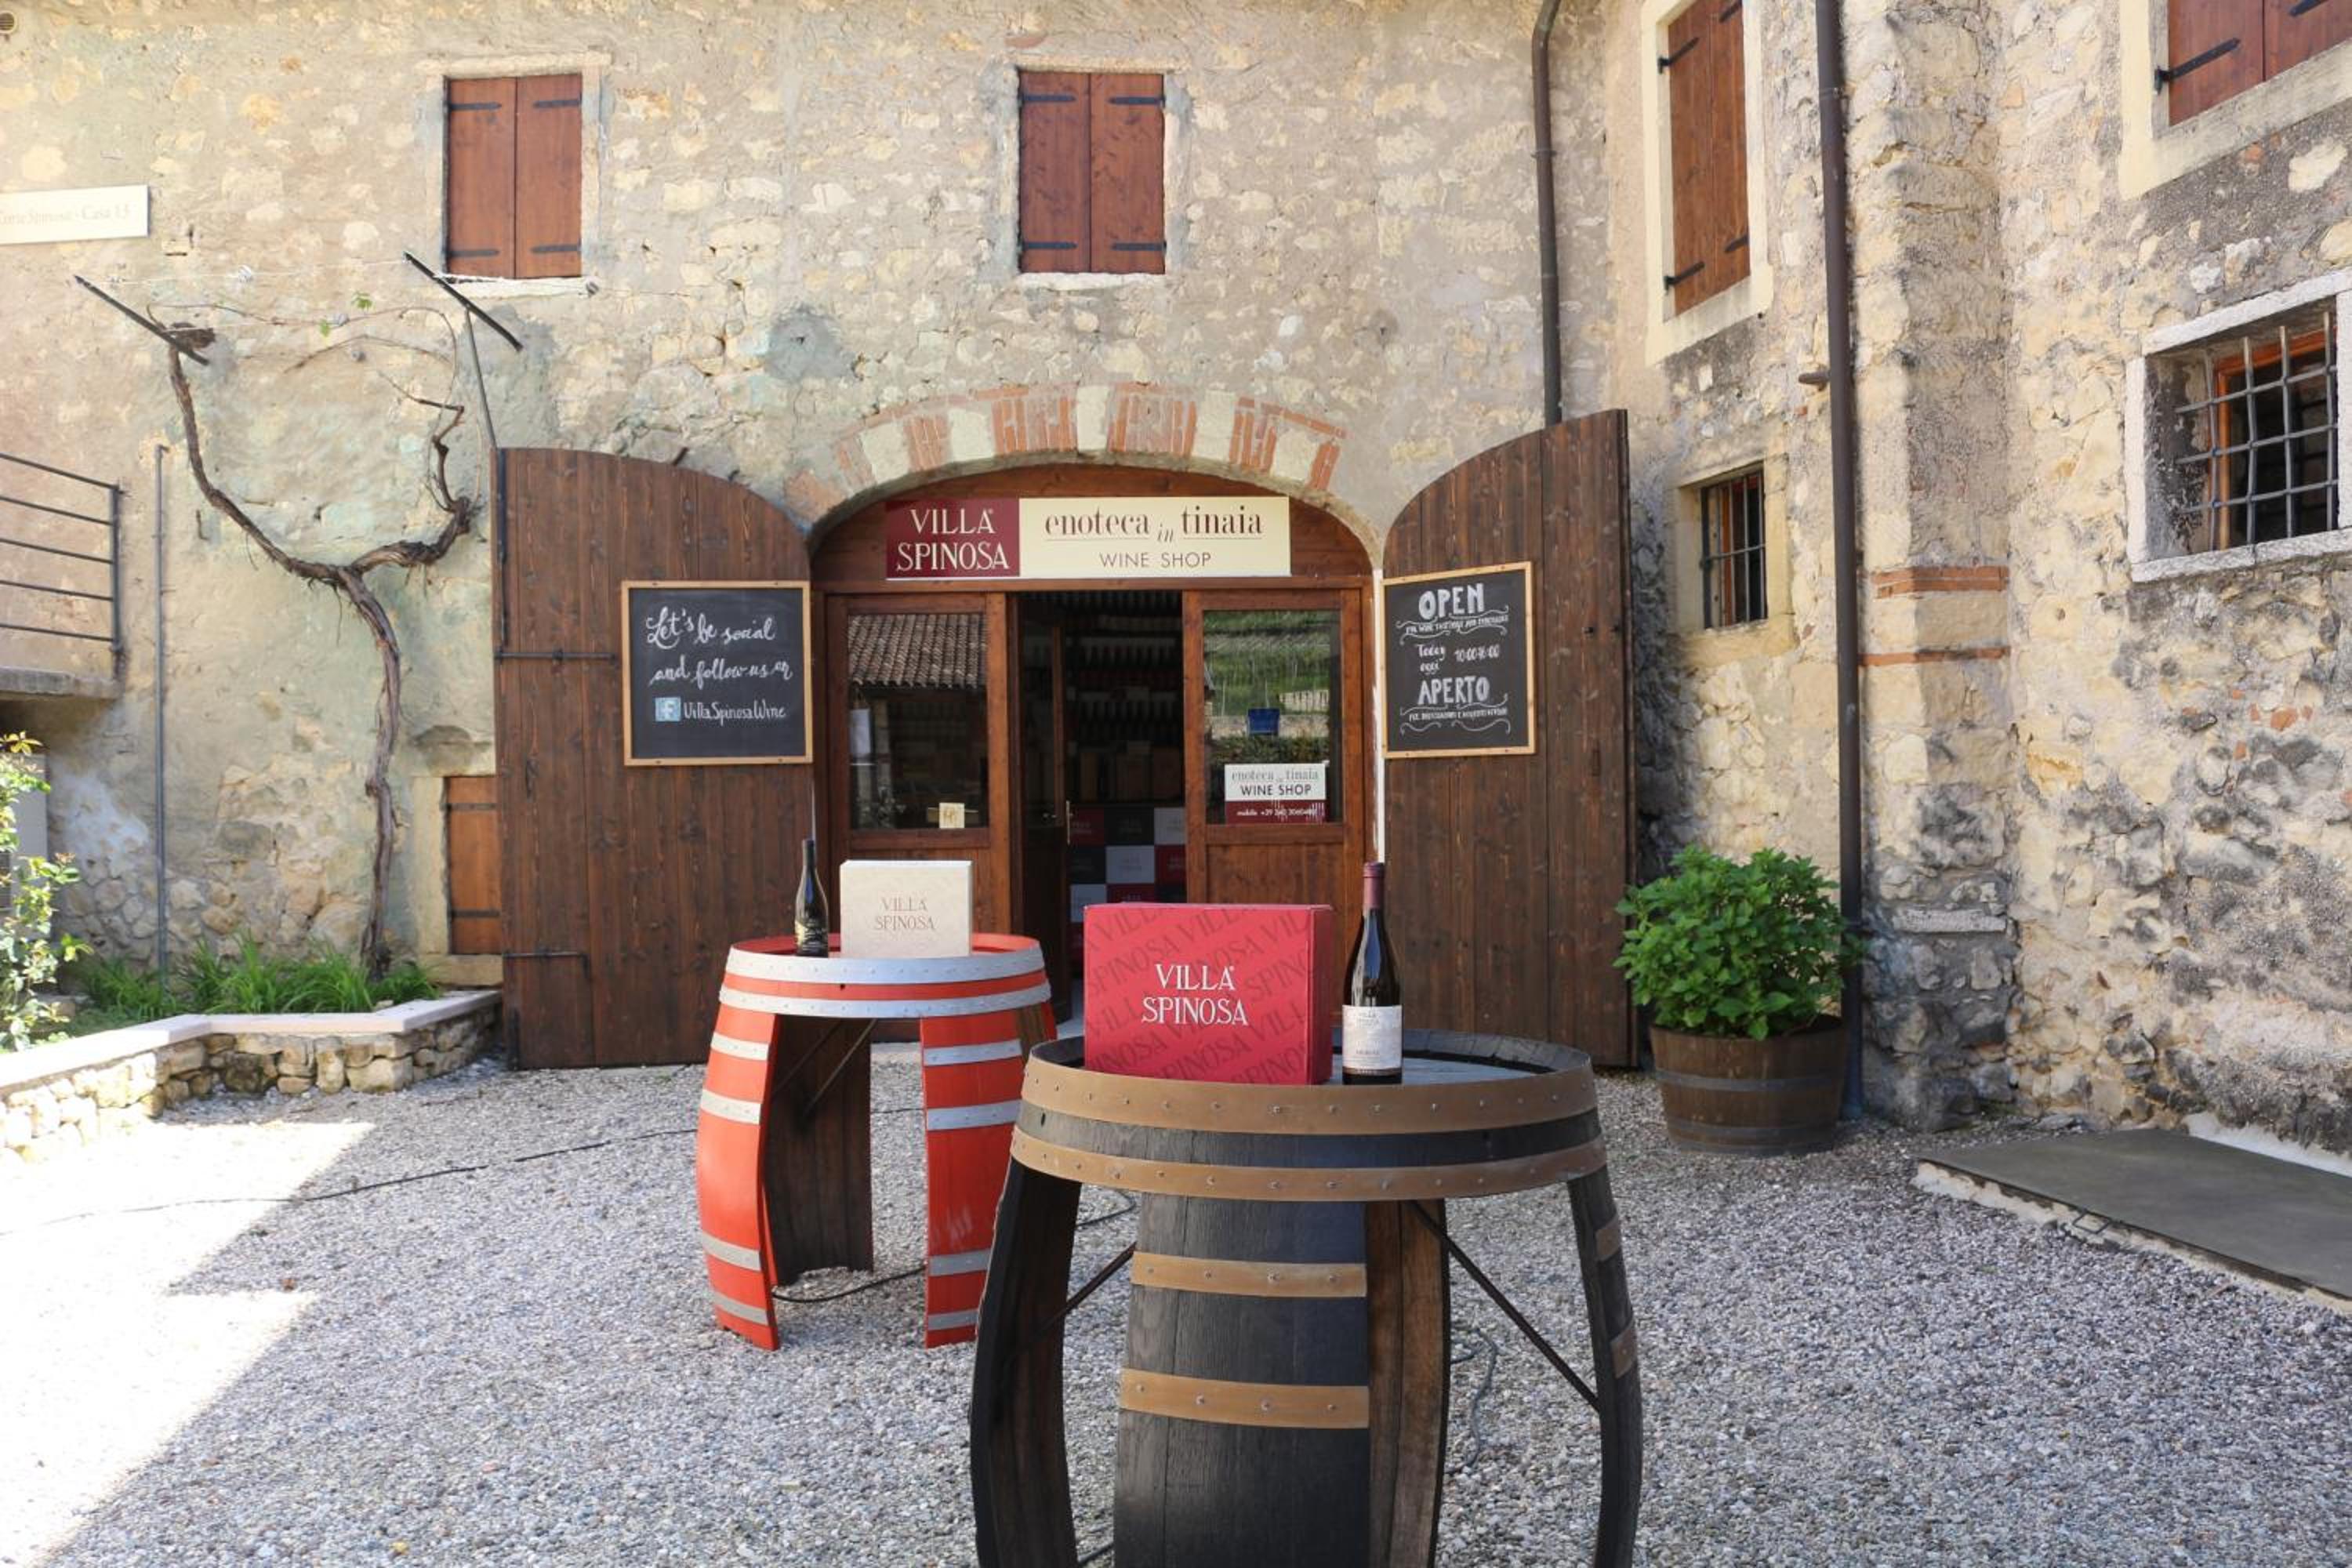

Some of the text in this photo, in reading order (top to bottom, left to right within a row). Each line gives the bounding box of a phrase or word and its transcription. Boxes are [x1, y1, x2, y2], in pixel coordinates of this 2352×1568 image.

[909, 508, 996, 535] VILLA
[1044, 505, 1264, 543] enoteca in tinaia
[896, 542, 1010, 572] SPINOSA
[1099, 552, 1212, 568] WINE SHOP
[1418, 583, 1486, 620] OPEN
[646, 605, 695, 650] Let's
[694, 613, 717, 644] be
[648, 655, 690, 687] and
[691, 658, 746, 690] follow
[749, 664, 768, 679] us
[1417, 676, 1490, 706] APERTO
[1240, 784, 1312, 796] WINE SHOP
[881, 897, 928, 912] VILLA
[873, 914, 937, 931] SPINOSA
[1155, 964, 1236, 991] VILLA
[1142, 996, 1250, 1026] SPINOSA
